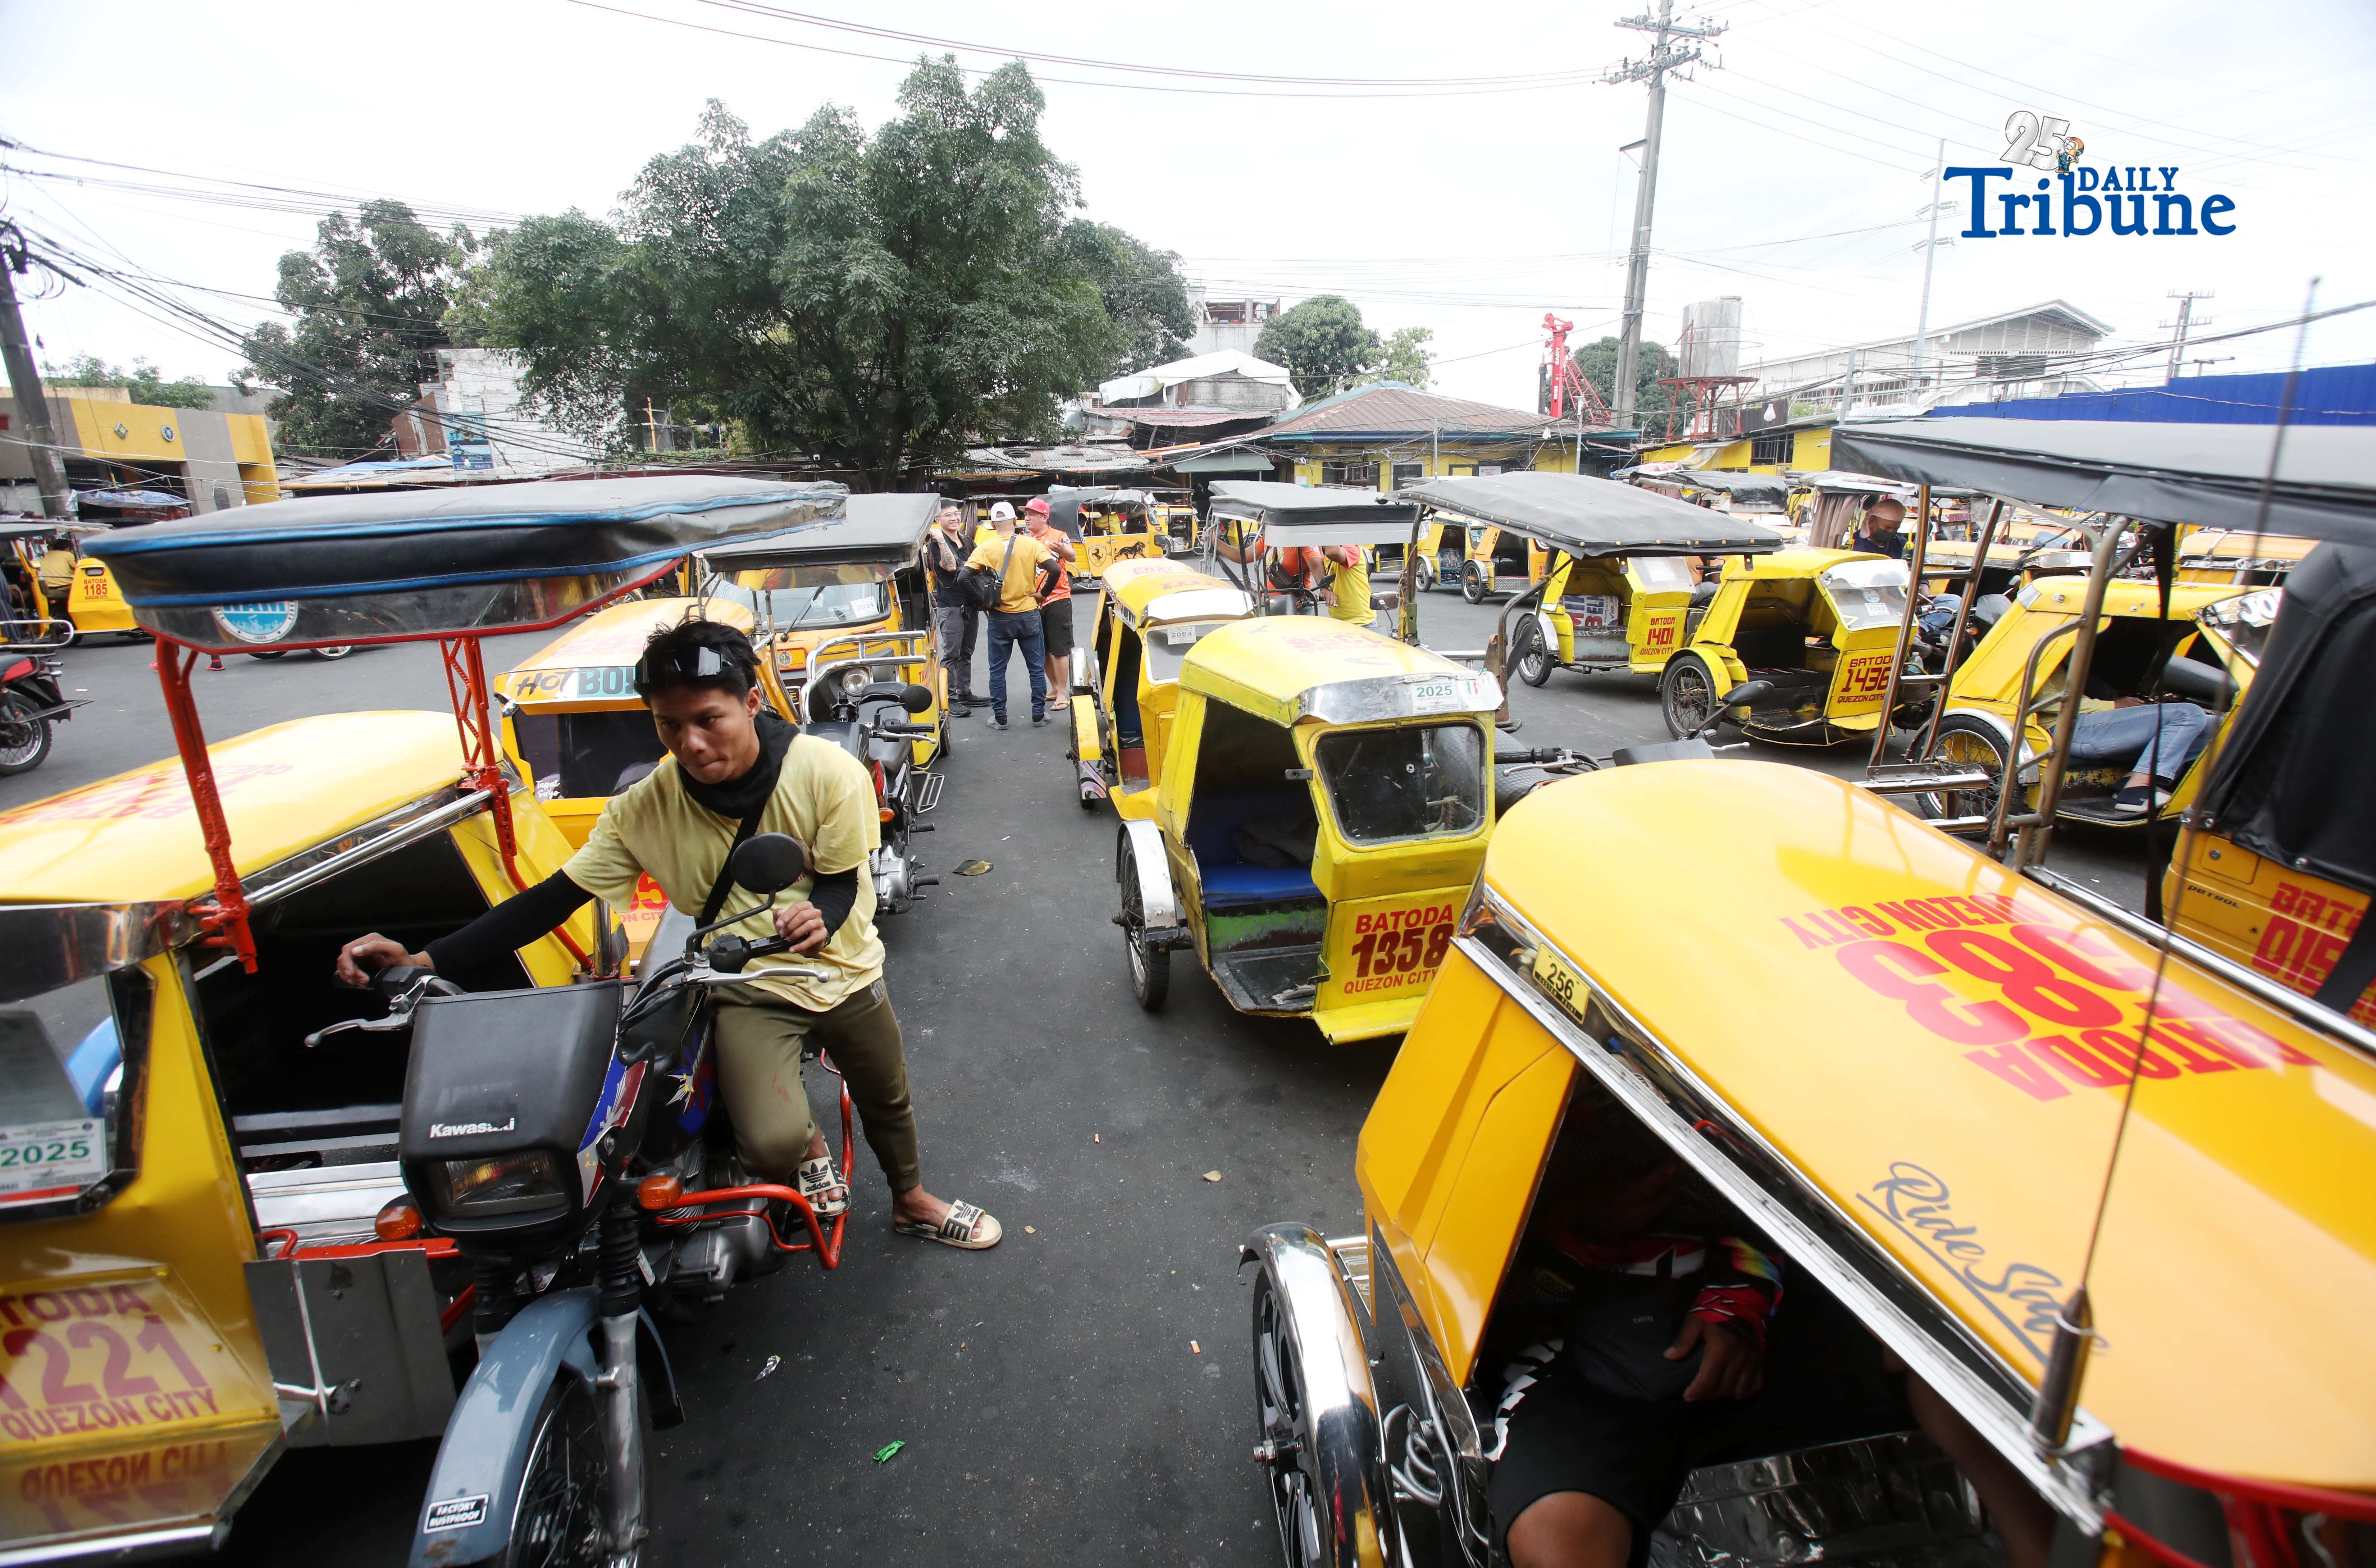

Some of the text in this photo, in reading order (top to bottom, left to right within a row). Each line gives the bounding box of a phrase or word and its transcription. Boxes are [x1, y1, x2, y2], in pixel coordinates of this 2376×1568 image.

[84, 584, 107, 595] 1185
[1651, 617, 1675, 625] BATODA
[1647, 628, 1674, 645] 1401
[515, 669, 579, 698] HOT
[1841, 666, 1892, 692] 1436
[1417, 685, 1452, 697] 2025
[1837, 693, 1885, 703] QUEZON CITY
[535, 779, 560, 789] Tapat
[538, 789, 560, 799] Sayo
[641, 912, 662, 921] CIT
[1356, 904, 1454, 934] BATODA
[1779, 894, 2047, 951] QUEZON CITY
[1351, 923, 1454, 978] 1358
[2251, 916, 2351, 995] 015
[1344, 967, 1438, 994] QUEZON CITY
[1547, 963, 1575, 1000] 256
[1962, 1018, 2324, 1102] BATODA
[0, 1140, 91, 1167] 2025
[805, 1180, 831, 1193] adidas
[968, 1208, 979, 1223] adidas
[1873, 1162, 1984, 1262] Ride
[0, 1284, 154, 1327] TODA
[1633, 1315, 1653, 1324] bellroy
[1, 1387, 220, 1442] QUEZON CITY
[429, 1509, 481, 1528] RUSTPROOF
[436, 1500, 478, 1516] FACTORY
